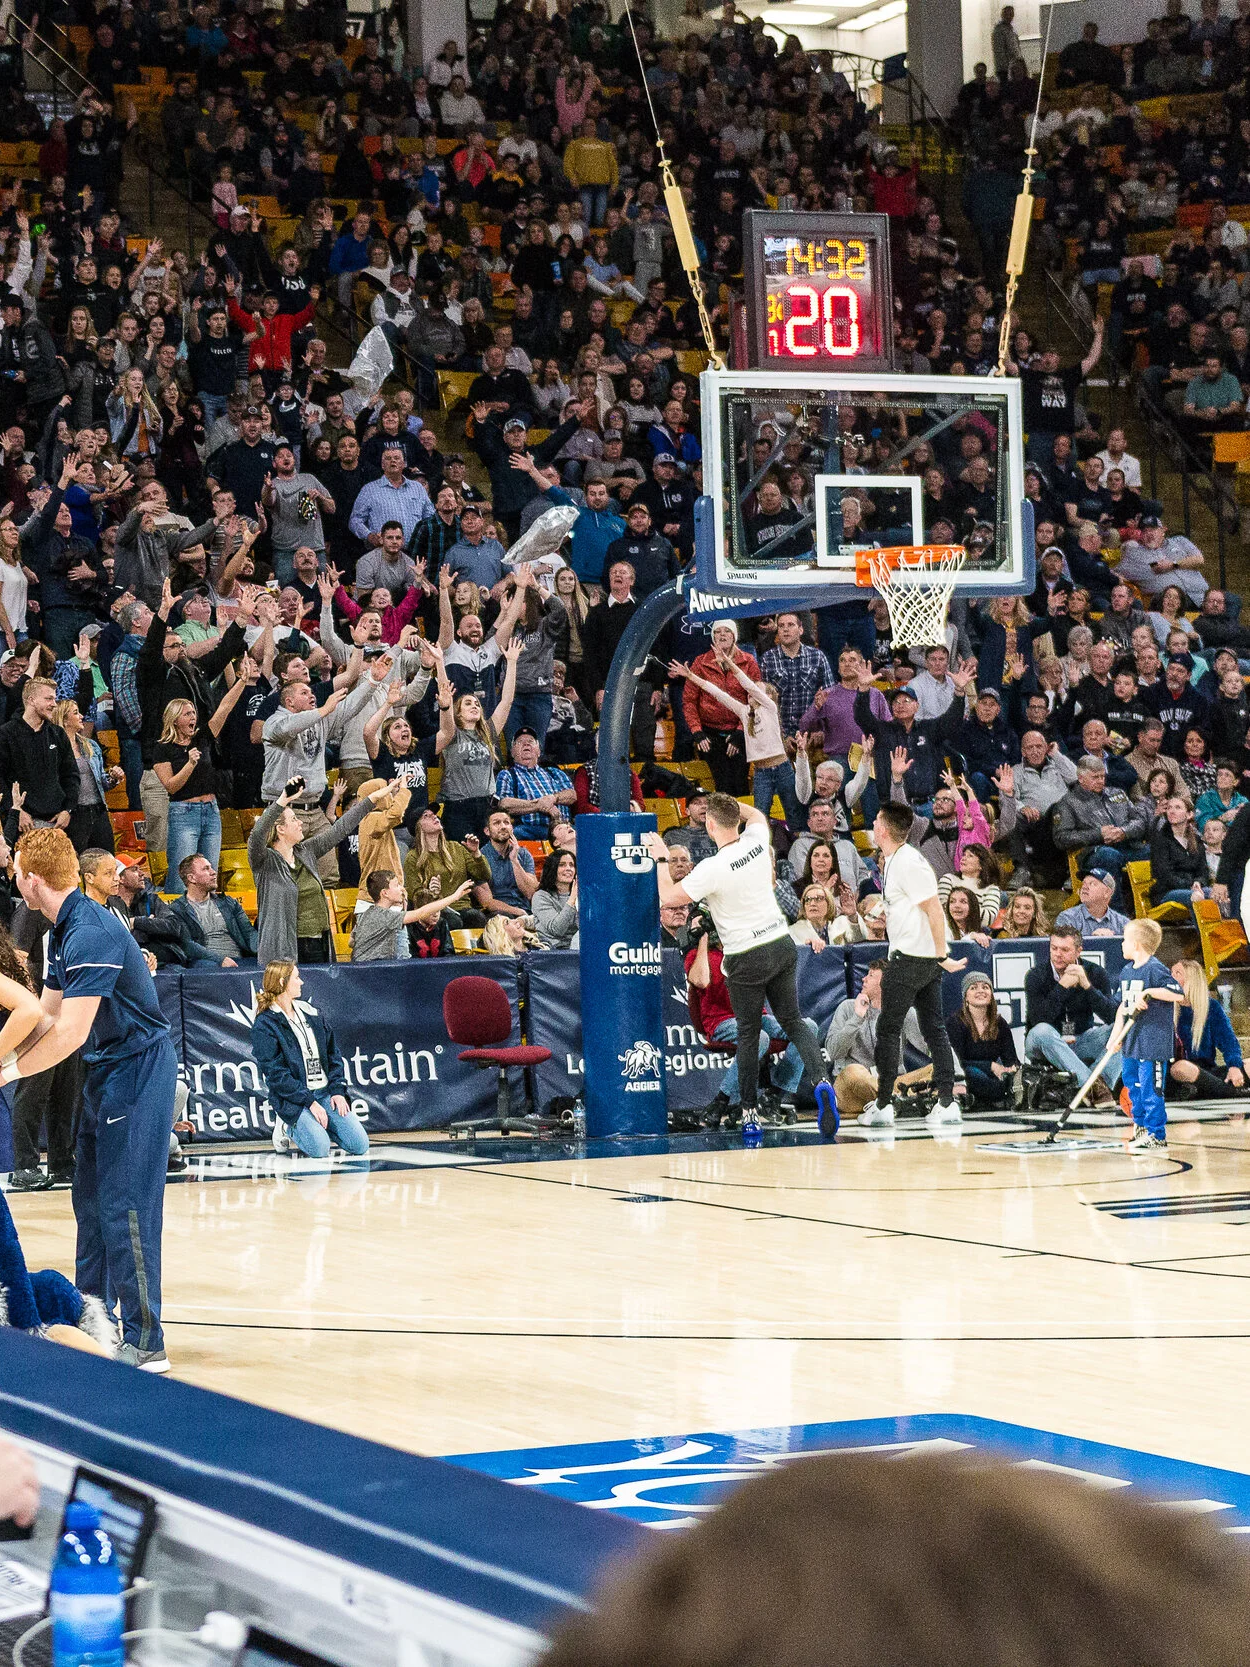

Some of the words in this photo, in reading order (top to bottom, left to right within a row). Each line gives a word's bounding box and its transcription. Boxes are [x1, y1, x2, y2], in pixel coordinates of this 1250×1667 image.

[786, 241, 865, 280] 14:32
[786, 286, 859, 356] 20
[727, 572, 758, 580] SPALDING
[608, 941, 661, 964] Guild
[609, 963, 662, 976] mortgage
[624, 1081, 660, 1092] AGGIES
